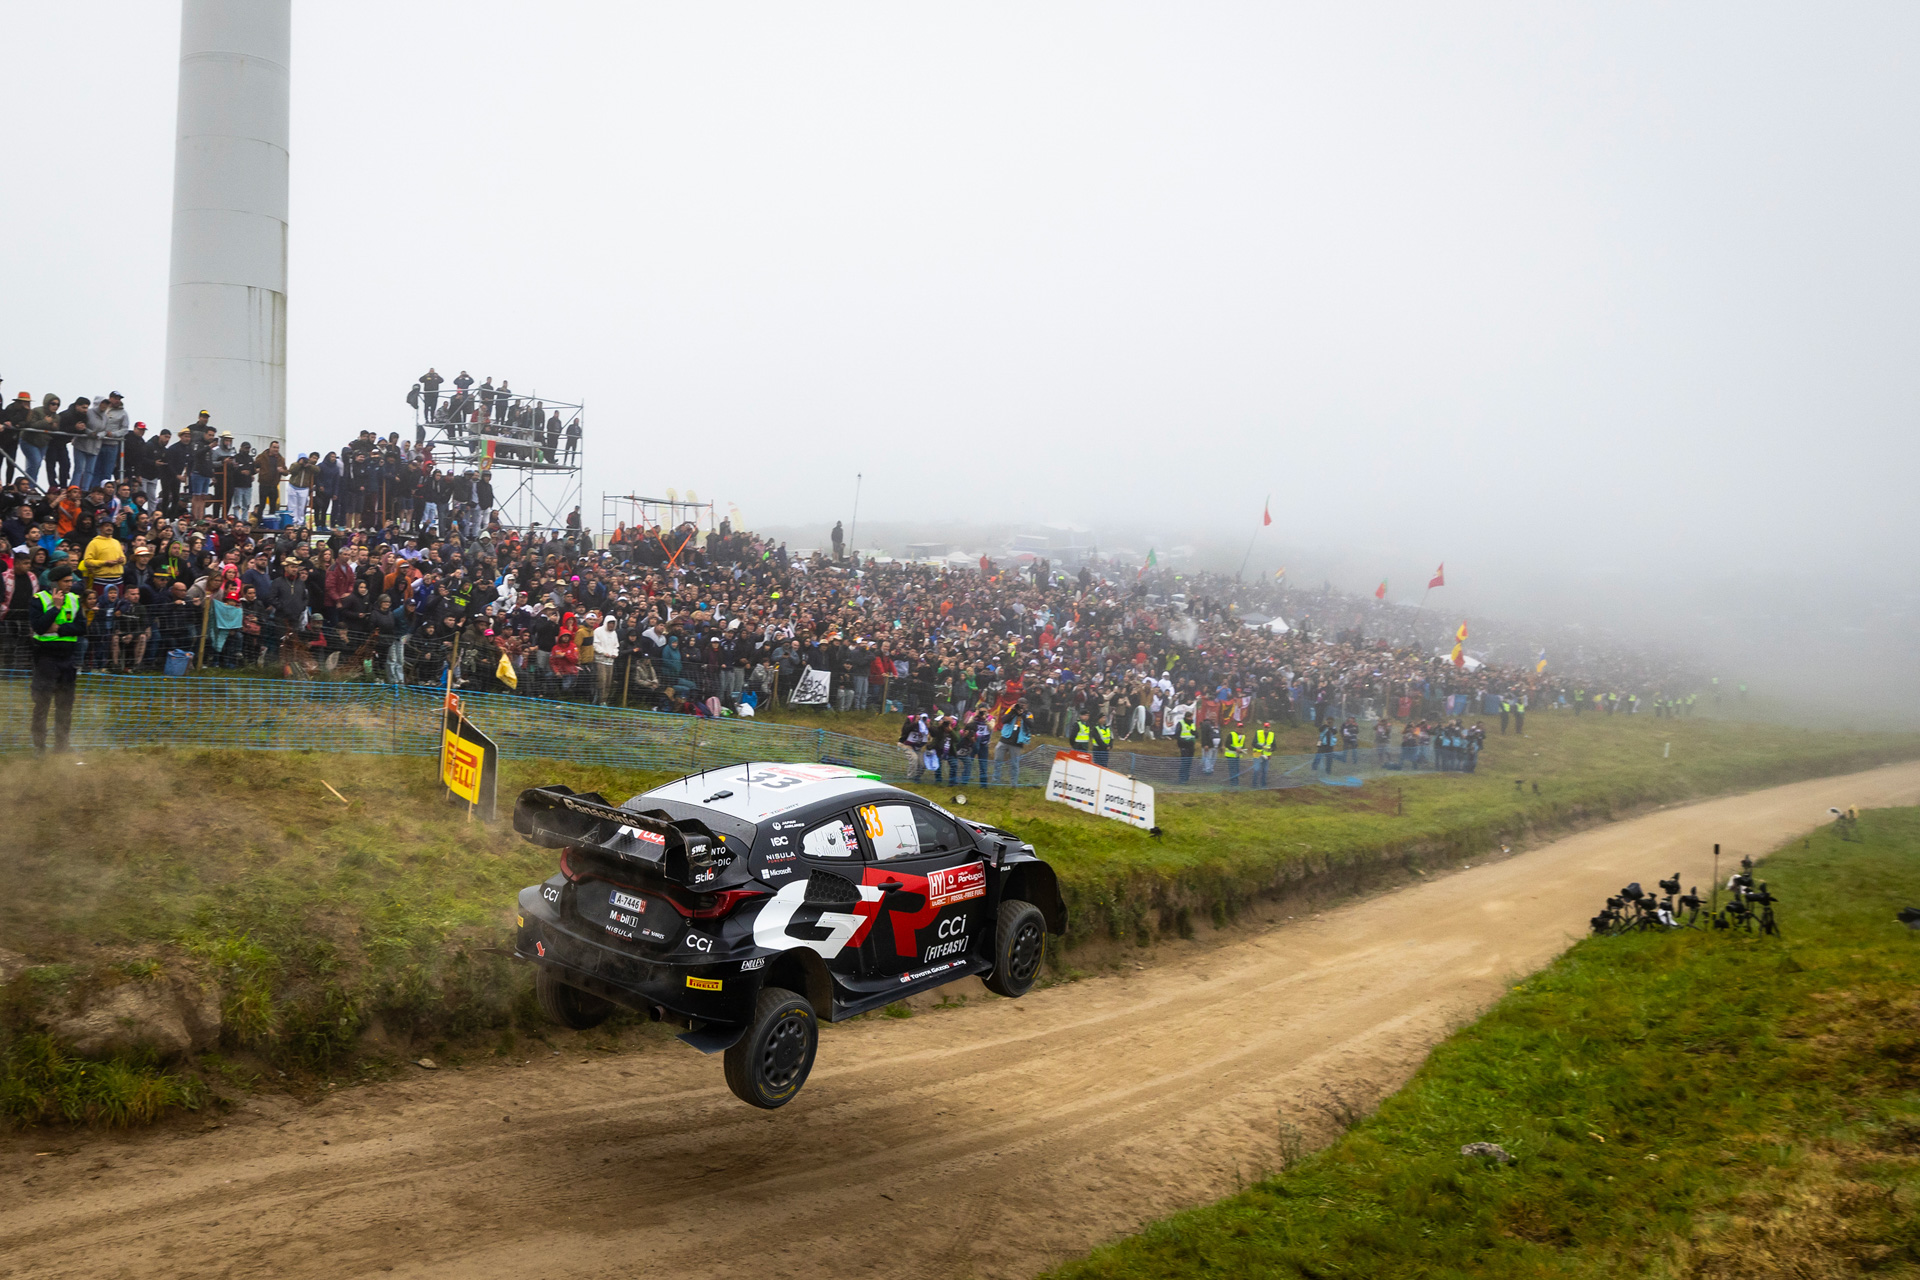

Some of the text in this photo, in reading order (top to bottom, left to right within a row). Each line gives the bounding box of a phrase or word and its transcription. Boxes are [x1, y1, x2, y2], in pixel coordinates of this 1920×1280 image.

[735, 771, 803, 789] 33
[1105, 793, 1125, 805] porto
[563, 798, 640, 828] Panasonic
[859, 804, 884, 839] 33
[711, 846, 726, 856] NTO
[766, 851, 796, 861] NISULA
[695, 867, 715, 883] Stilo
[769, 866, 793, 877] Microsoft
[958, 872, 983, 883] Portugal
[930, 873, 943, 896] HY
[543, 887, 560, 902] CCi
[616, 894, 641, 910] A-7446
[609, 910, 630, 925] Mobil
[605, 924, 633, 939] NISULA
[938, 914, 967, 939] CCi
[686, 934, 713, 953] CCi
[740, 957, 765, 970] ENDLESS
[910, 968, 931, 979] TOYOTA
[689, 978, 720, 989] PIRELLI
